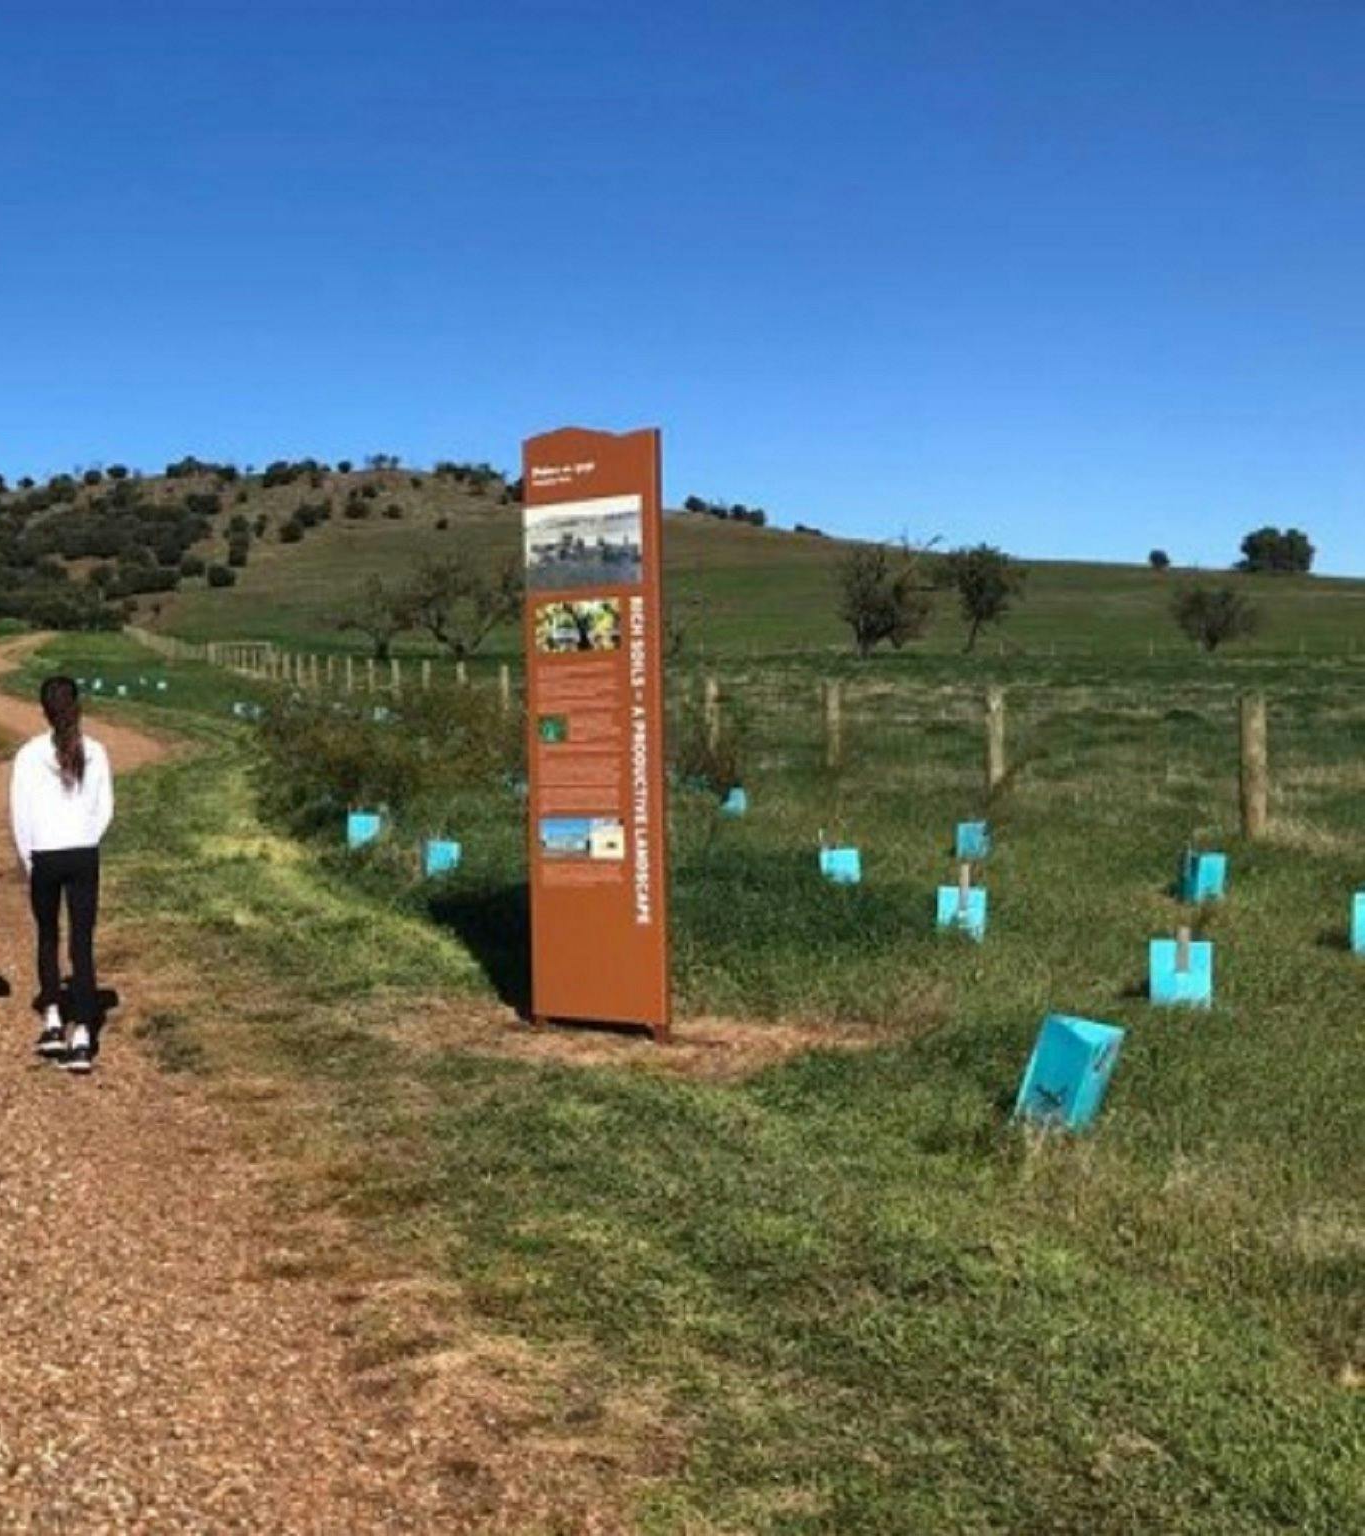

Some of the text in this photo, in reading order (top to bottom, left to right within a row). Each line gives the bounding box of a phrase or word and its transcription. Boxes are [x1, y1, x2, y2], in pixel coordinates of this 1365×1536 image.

[629, 596, 645, 636] RICH
[629, 639, 646, 687] SOILS
[630, 706, 646, 720] A
[631, 720, 648, 824] PRODUCTIVE
[634, 827, 650, 924] LANDSCAPE
